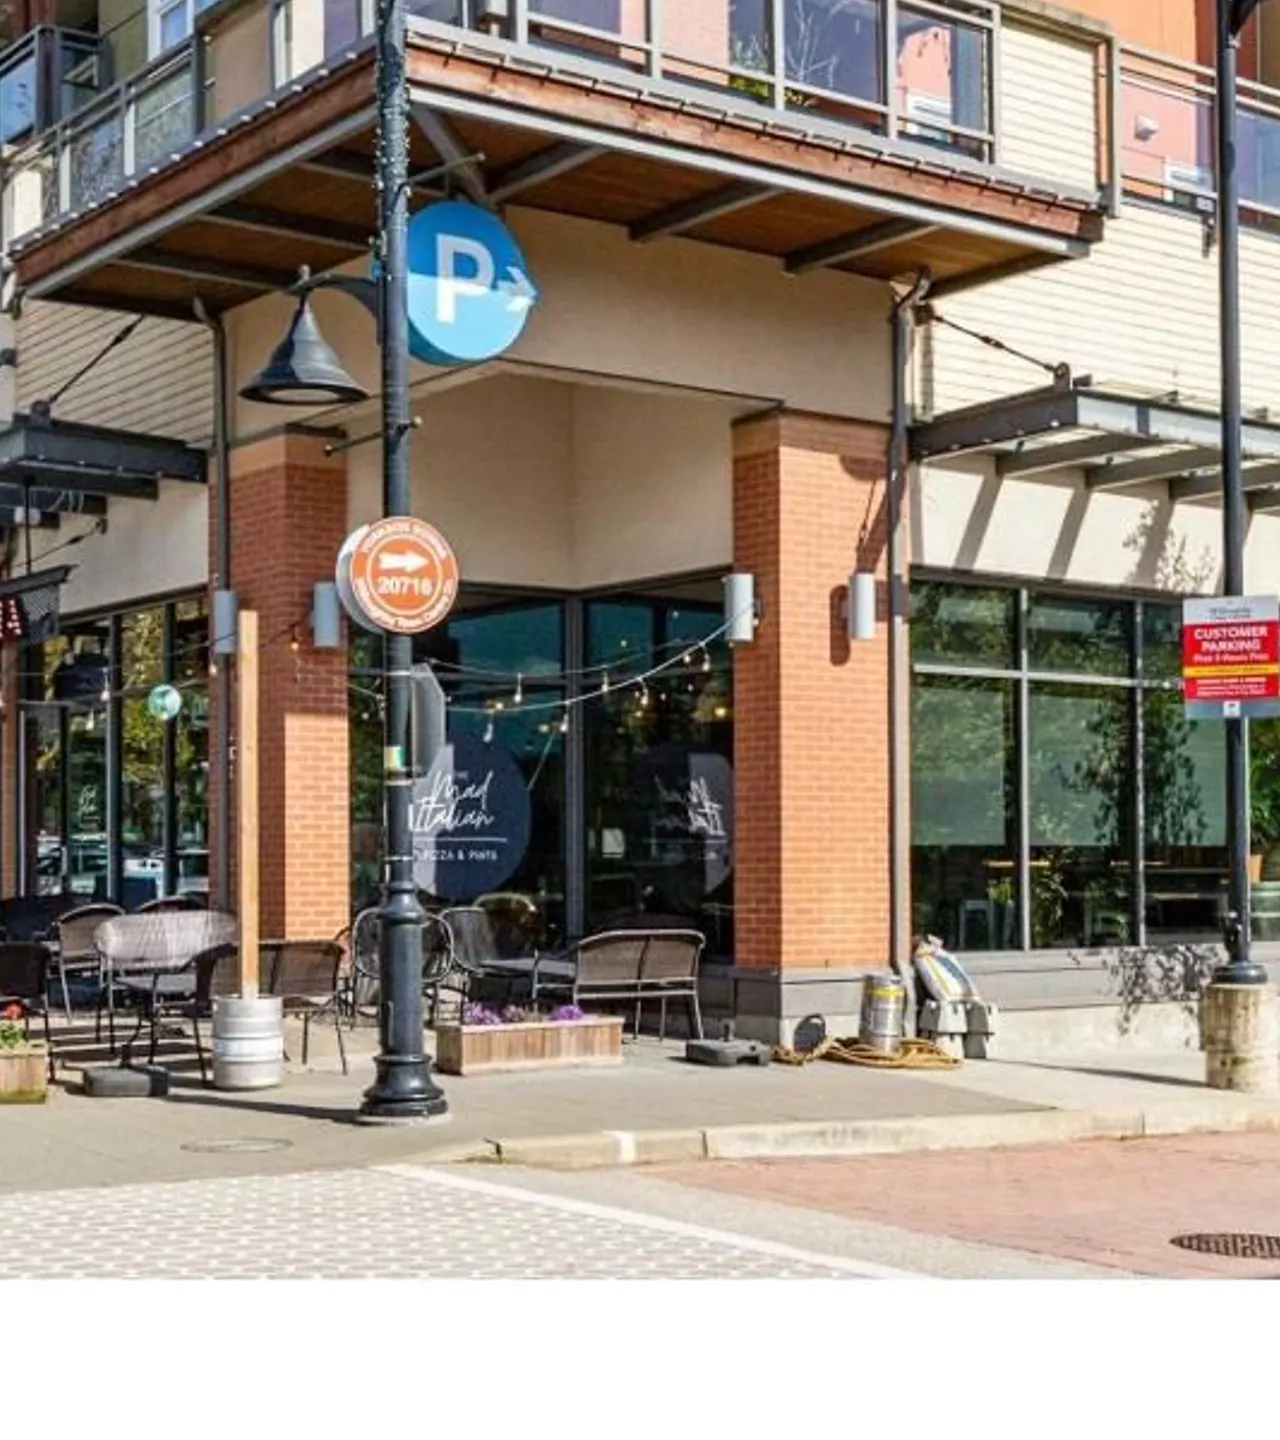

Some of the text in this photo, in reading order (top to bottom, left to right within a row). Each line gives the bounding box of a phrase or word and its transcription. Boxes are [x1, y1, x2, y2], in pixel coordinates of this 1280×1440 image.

[436, 233, 495, 326] P
[1194, 626, 1268, 640] CUSTOMER
[1201, 639, 1262, 652] PARKING
[417, 769, 494, 810] Mad
[408, 803, 495, 831] Italian
